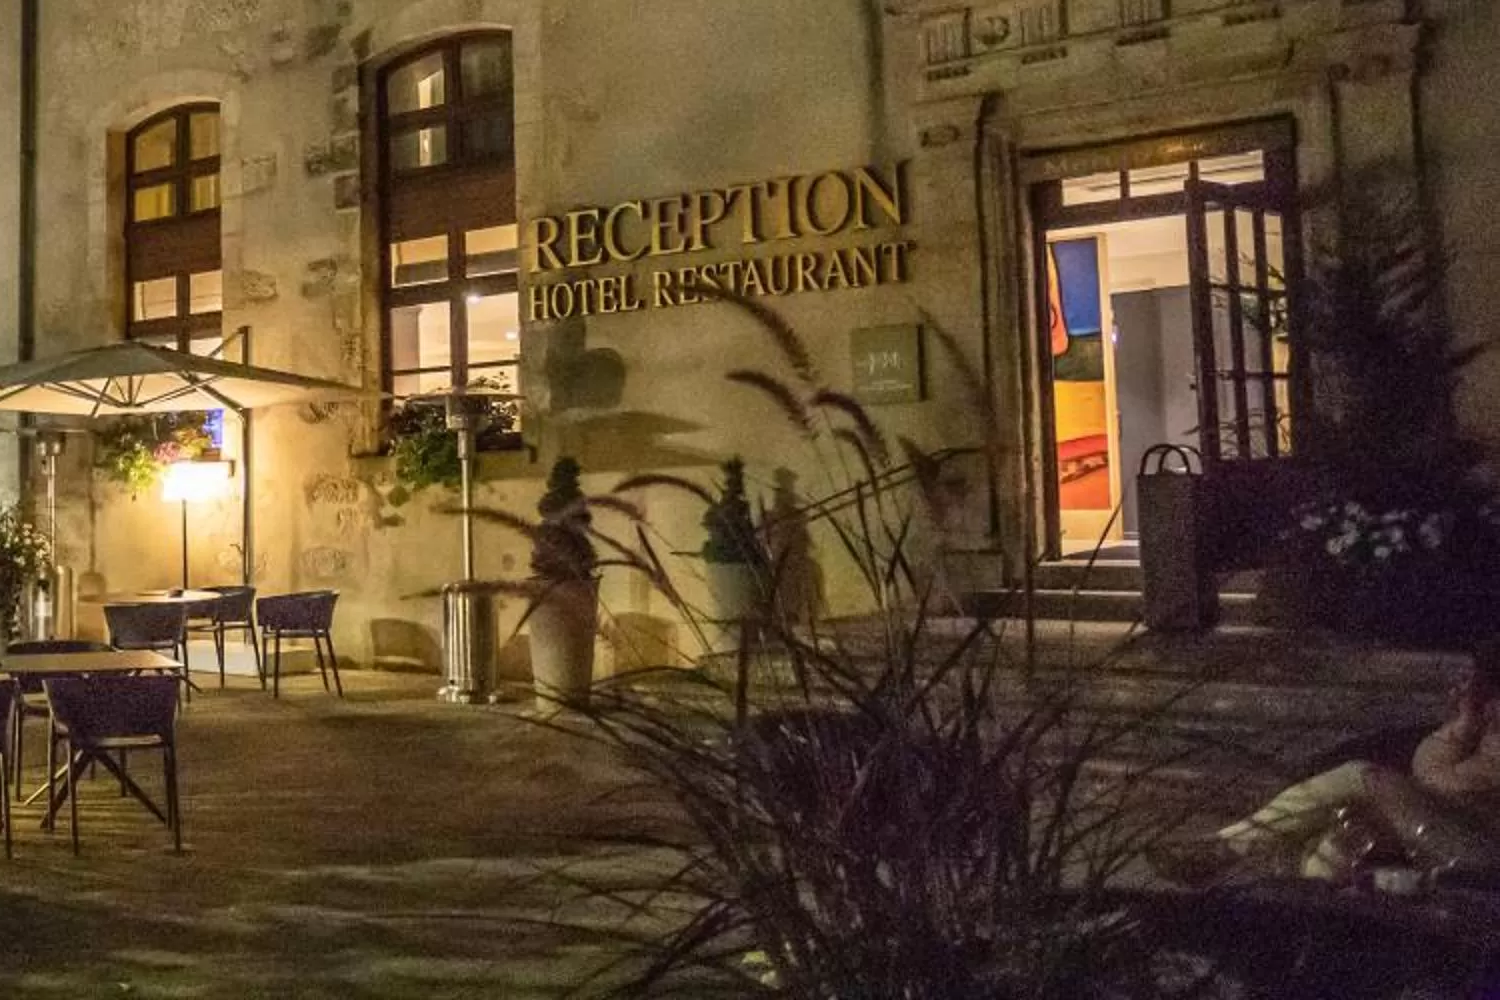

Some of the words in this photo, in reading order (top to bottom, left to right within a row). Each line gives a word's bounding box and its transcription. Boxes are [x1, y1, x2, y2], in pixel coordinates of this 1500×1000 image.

[530, 164, 906, 273] RECEPTION
[529, 275, 640, 321] HOTEL
[652, 242, 911, 308] RESTAURANT
